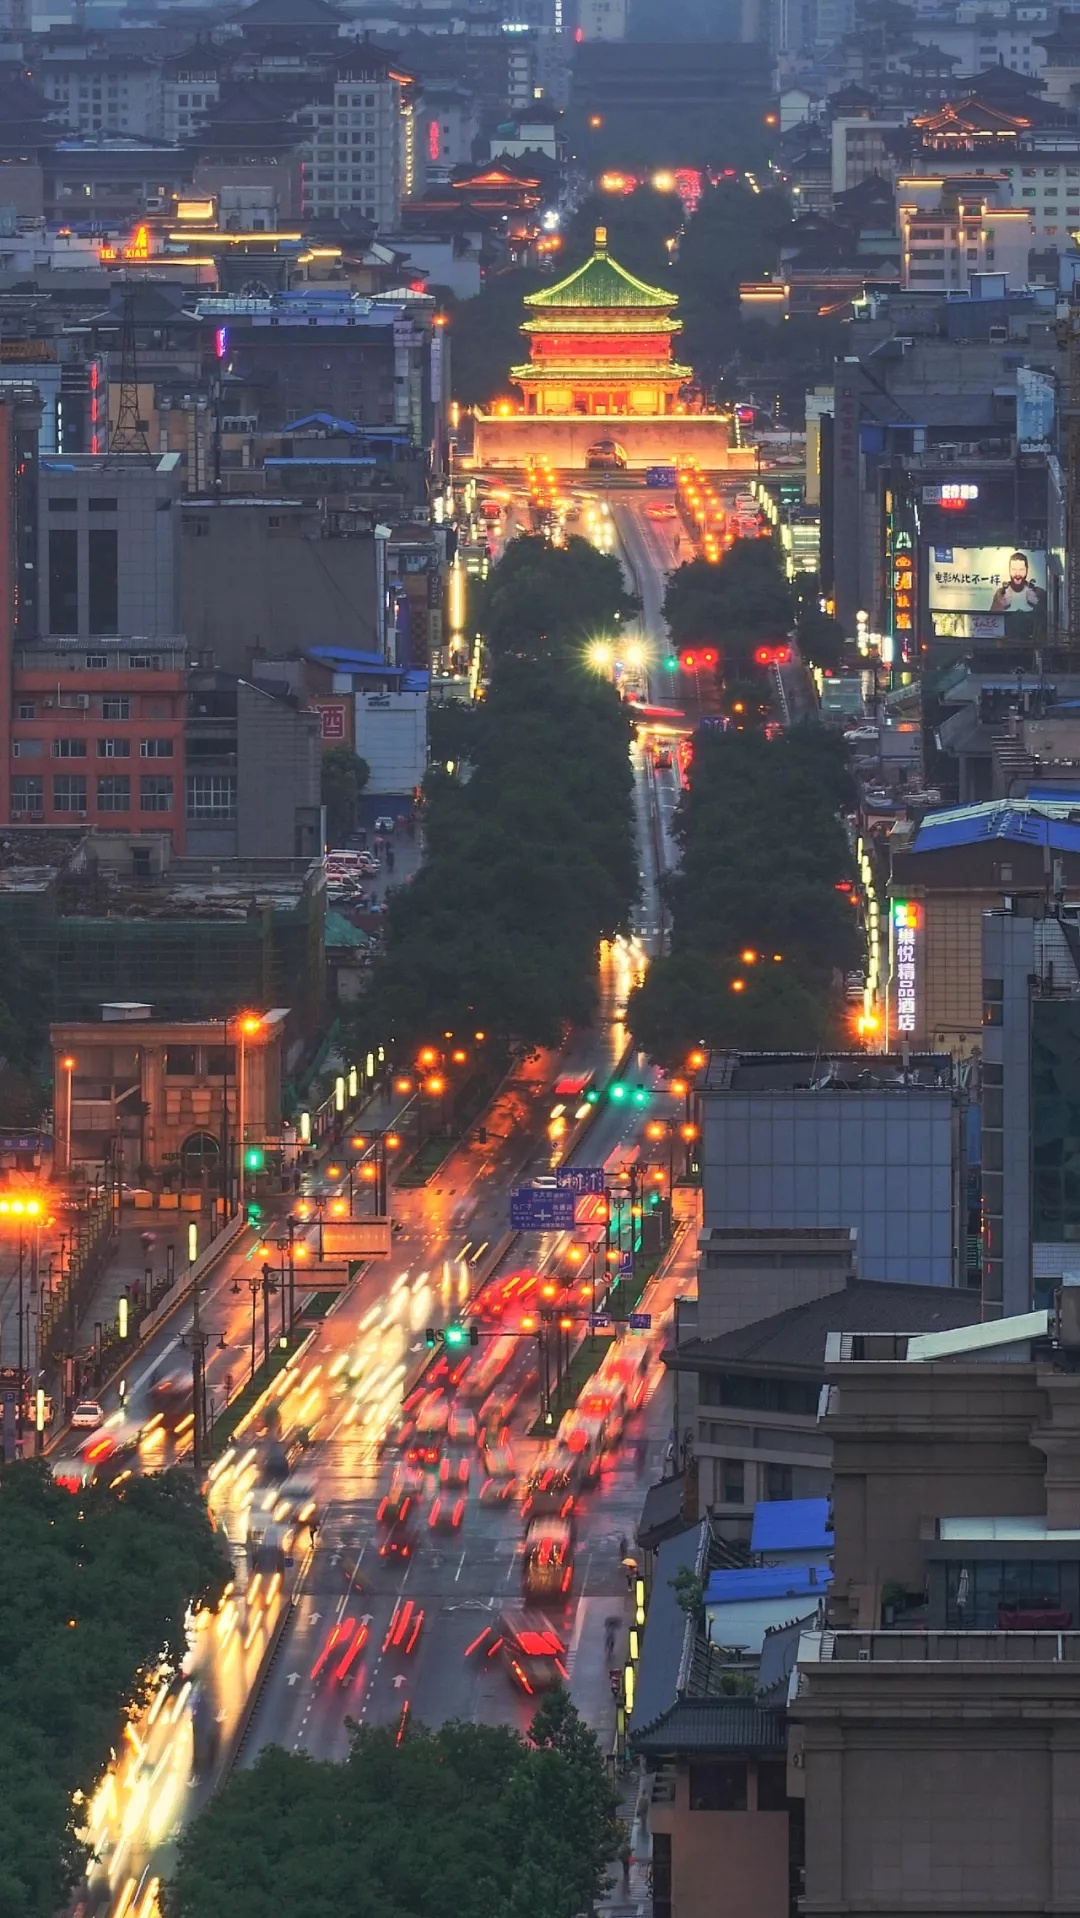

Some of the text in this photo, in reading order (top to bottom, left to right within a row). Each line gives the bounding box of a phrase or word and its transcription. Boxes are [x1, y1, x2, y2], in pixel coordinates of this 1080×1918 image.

[101, 249, 116, 259] TEL
[897, 928, 915, 1031] 巢悦精品酒店
